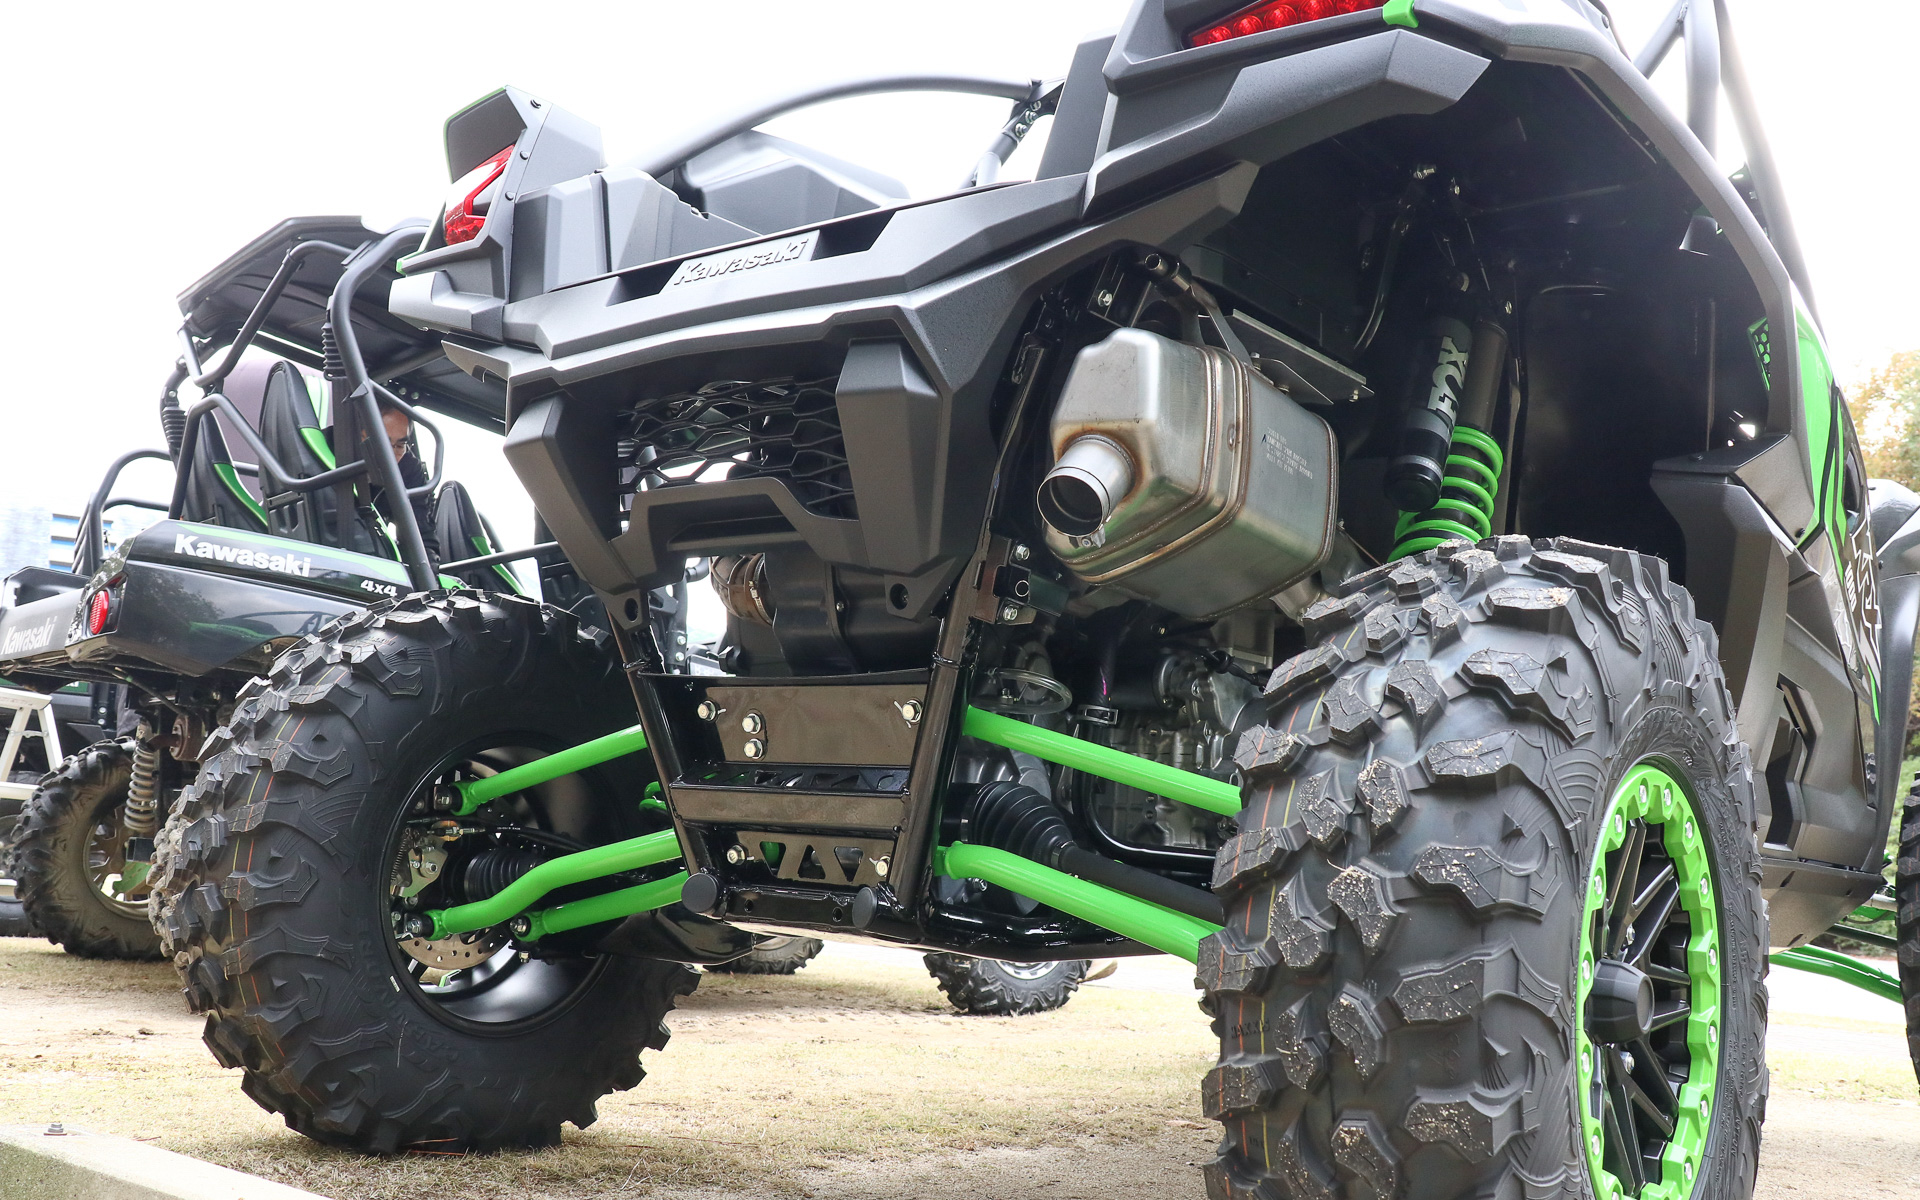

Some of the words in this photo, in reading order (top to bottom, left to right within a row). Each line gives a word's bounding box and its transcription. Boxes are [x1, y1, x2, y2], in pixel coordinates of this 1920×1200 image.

[674, 238, 809, 286] Kawasaki
[1427, 335, 1469, 428] FOX
[174, 533, 311, 578] Kawasaki
[360, 578, 398, 598] 4x4
[1844, 561, 1857, 613] 1000
[1, 616, 56, 655] Kawasaki
